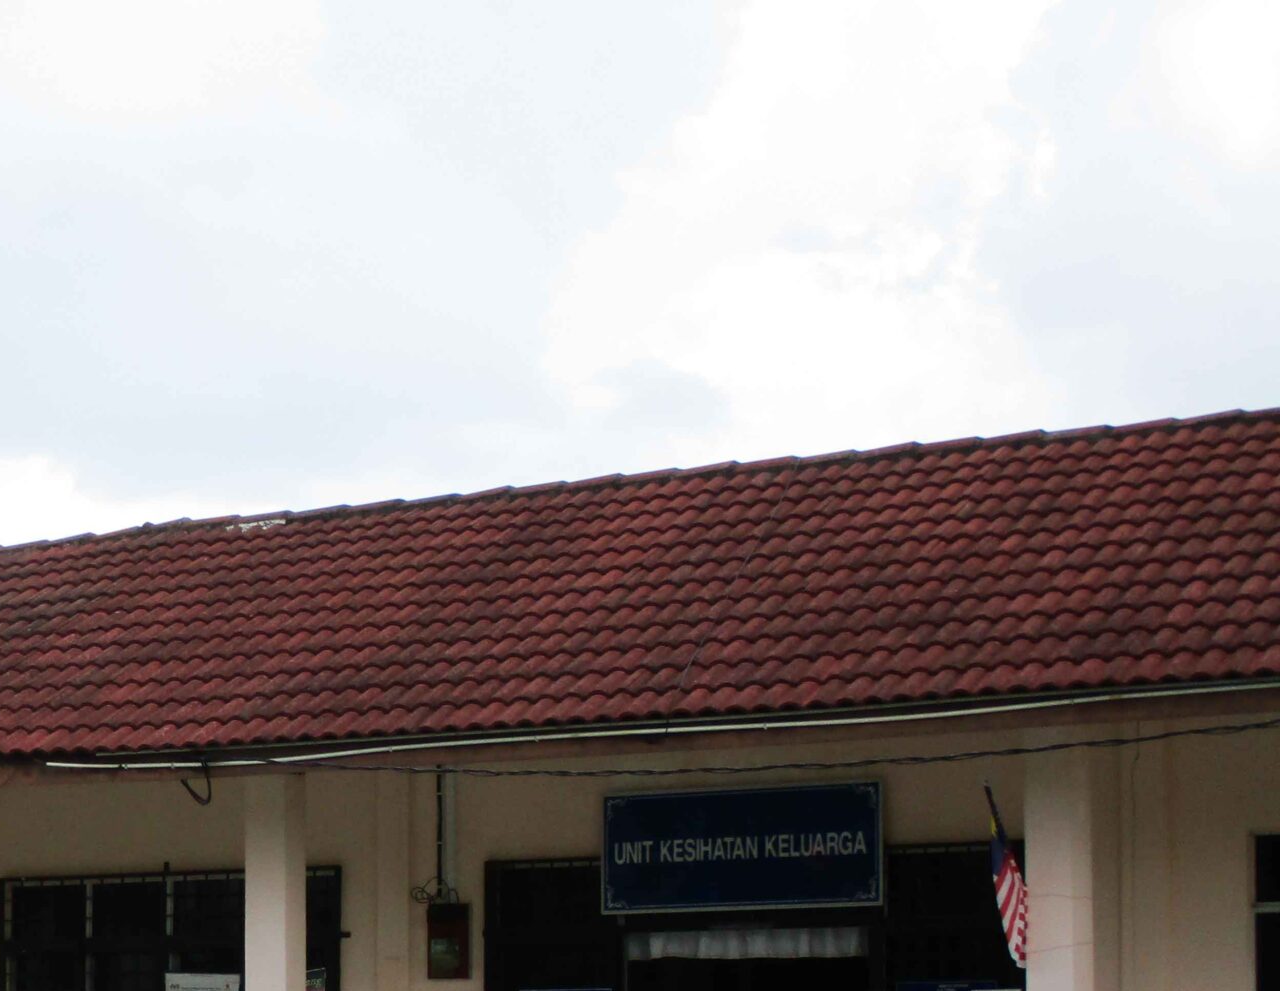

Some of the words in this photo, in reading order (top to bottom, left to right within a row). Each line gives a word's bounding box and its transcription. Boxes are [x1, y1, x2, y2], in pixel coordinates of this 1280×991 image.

[614, 840, 654, 865] UNIT
[660, 836, 758, 863] KESIHATAN
[764, 831, 867, 859] KELUARGA
